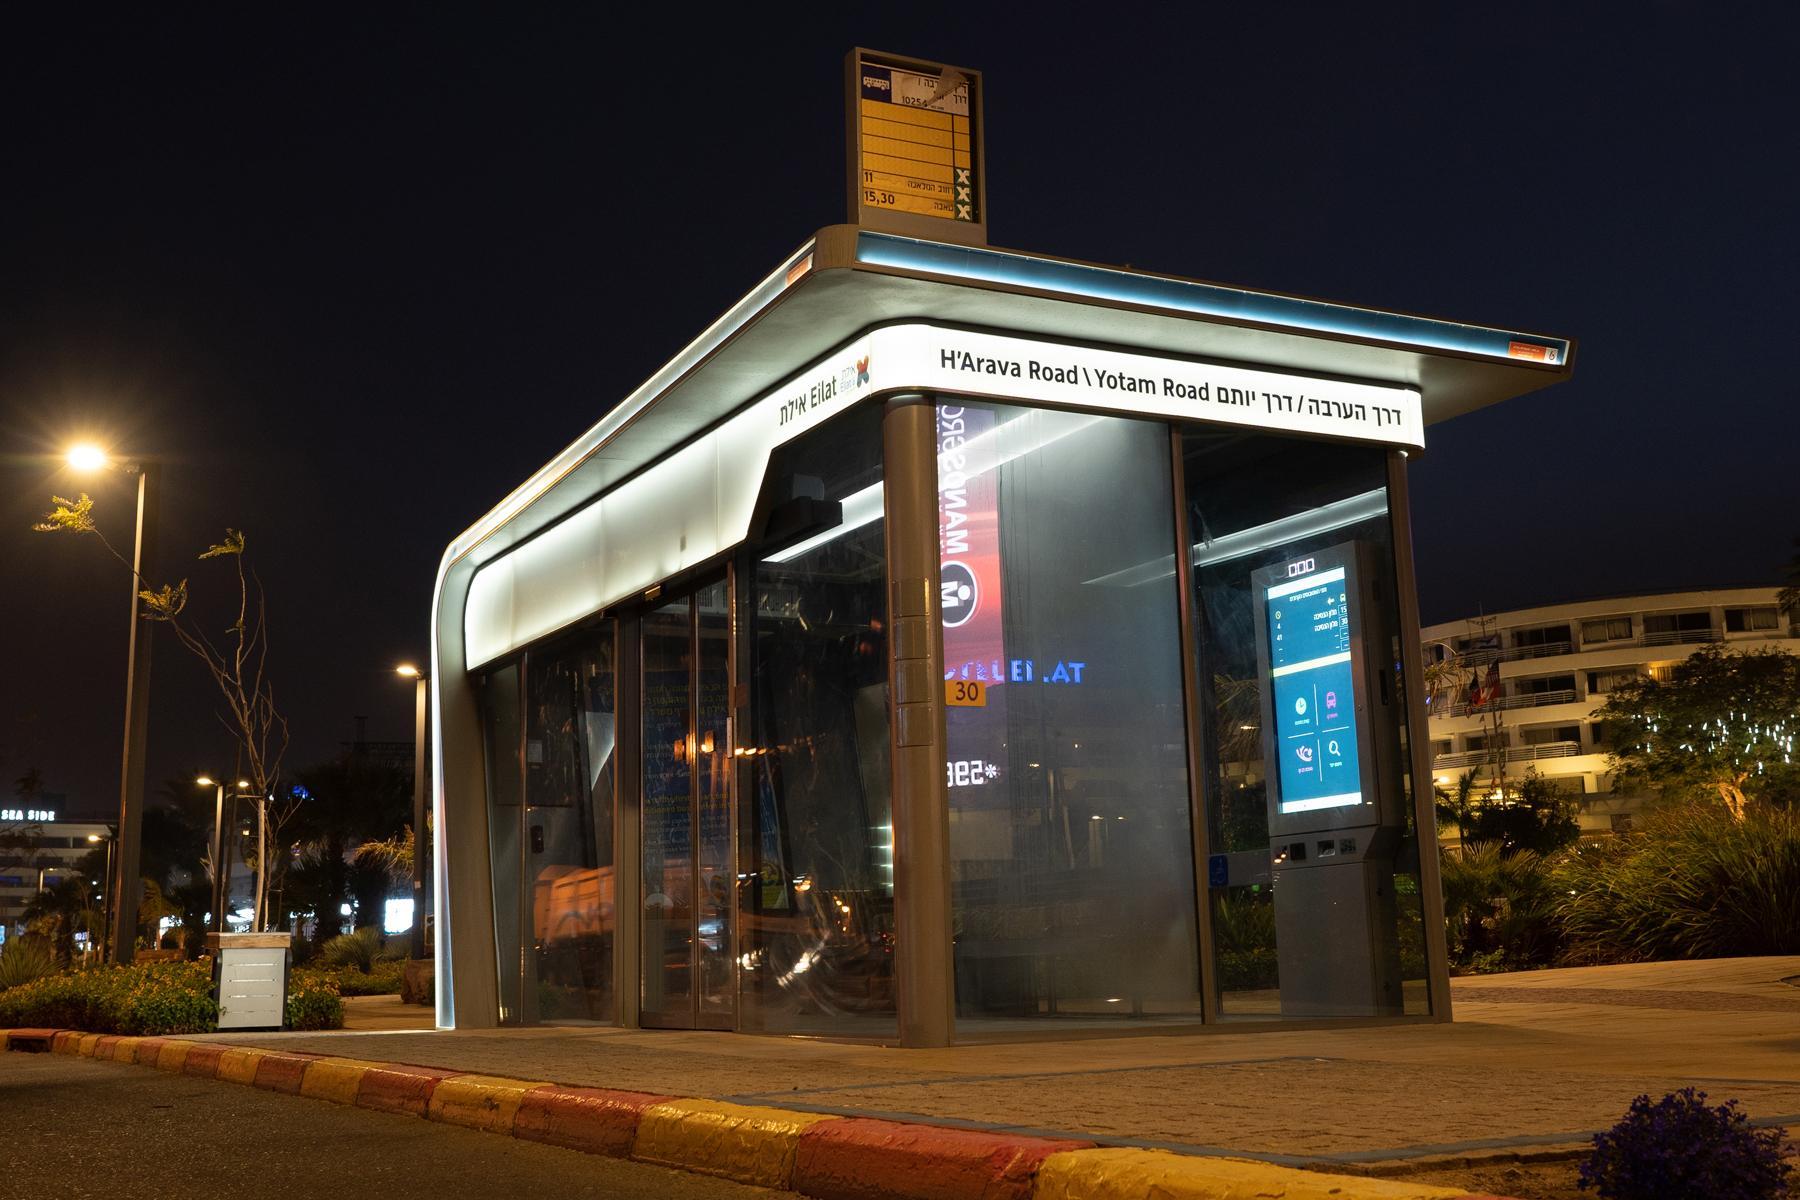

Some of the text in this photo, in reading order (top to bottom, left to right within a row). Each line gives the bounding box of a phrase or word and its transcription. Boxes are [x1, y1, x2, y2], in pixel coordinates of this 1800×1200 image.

[864, 171, 873, 183] 11
[864, 190, 896, 206] 15,30
[941, 348, 1021, 385] H'Arava
[1029, 360, 1079, 387] Road
[1095, 368, 1156, 395] Yotam
[1163, 377, 1210, 402] Road
[810, 375, 837, 409] Eilat
[1216, 386, 1256, 407] יותם
[780, 393, 807, 426] אילת
[1261, 392, 1293, 414] דרך
[1308, 398, 1366, 421] הערבה
[1371, 406, 1401, 427] דרך
[956, 681, 979, 702] 30
[1, 809, 55, 822] SEA SIDE
